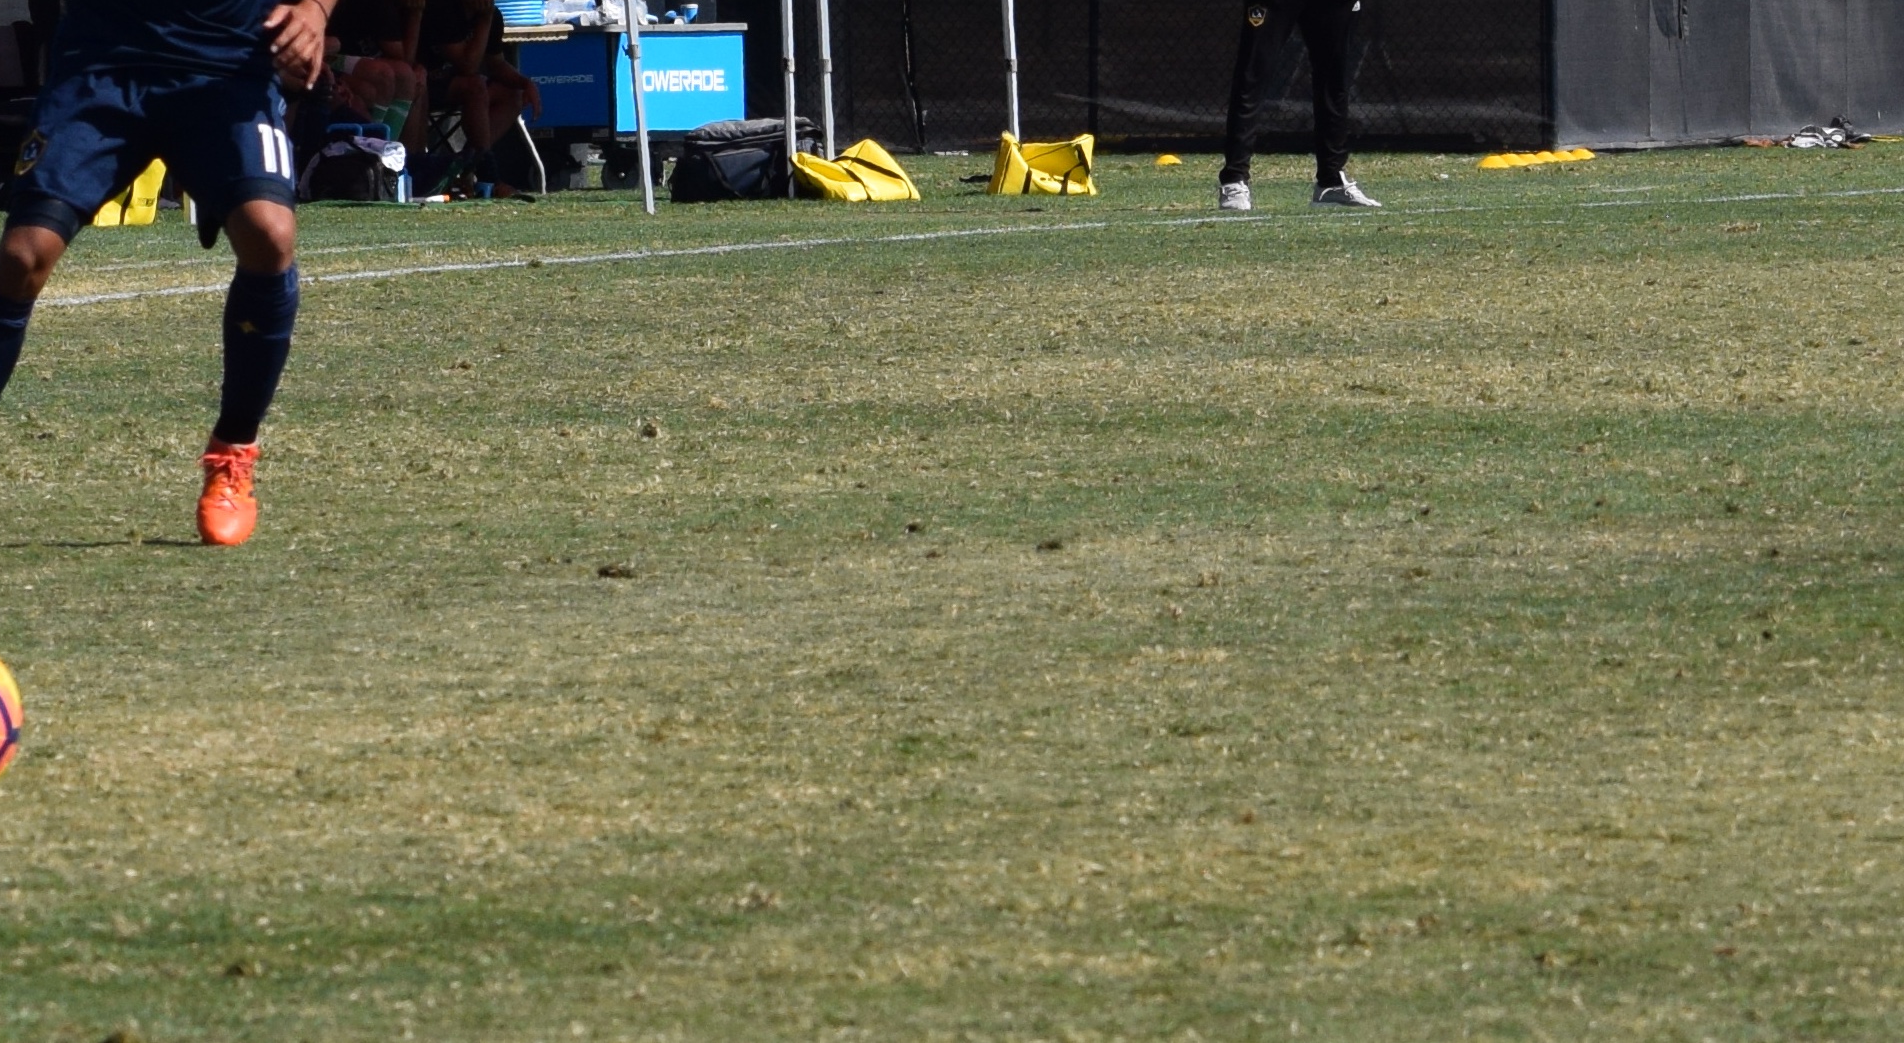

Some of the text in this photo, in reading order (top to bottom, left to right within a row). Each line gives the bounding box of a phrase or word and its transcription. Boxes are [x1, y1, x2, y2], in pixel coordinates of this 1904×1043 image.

[530, 74, 594, 86] POWERADE
[641, 69, 725, 92] OWERADE
[257, 123, 291, 180] 11
